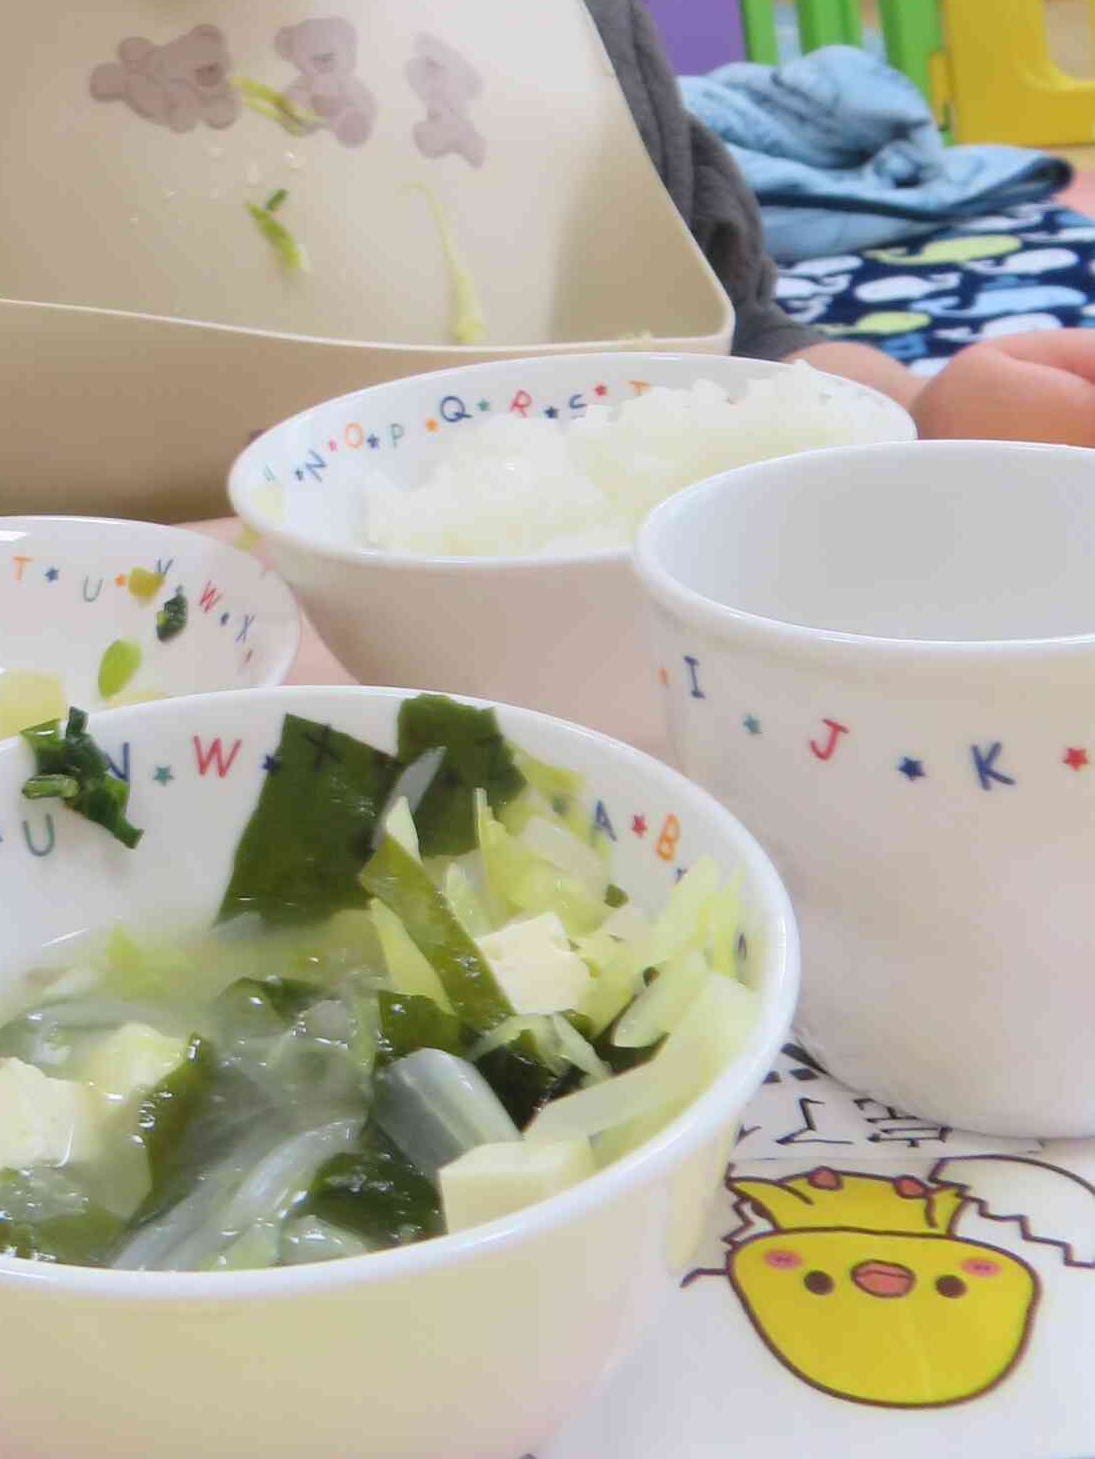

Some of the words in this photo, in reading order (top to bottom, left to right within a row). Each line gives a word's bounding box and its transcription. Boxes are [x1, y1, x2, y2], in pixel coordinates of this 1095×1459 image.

[388, 423, 405, 449] P
[440, 395, 472, 422] Q
[509, 388, 533, 419] R
[13, 555, 34, 584] T
[82, 575, 104, 603] U
[199, 580, 223, 613] W
[683, 654, 706, 699] I
[809, 717, 851, 762] J
[971, 742, 1018, 792] K
[22, 813, 56, 857] U
[193, 735, 243, 779] W
[593, 799, 617, 842] A
[655, 813, 682, 861] B
